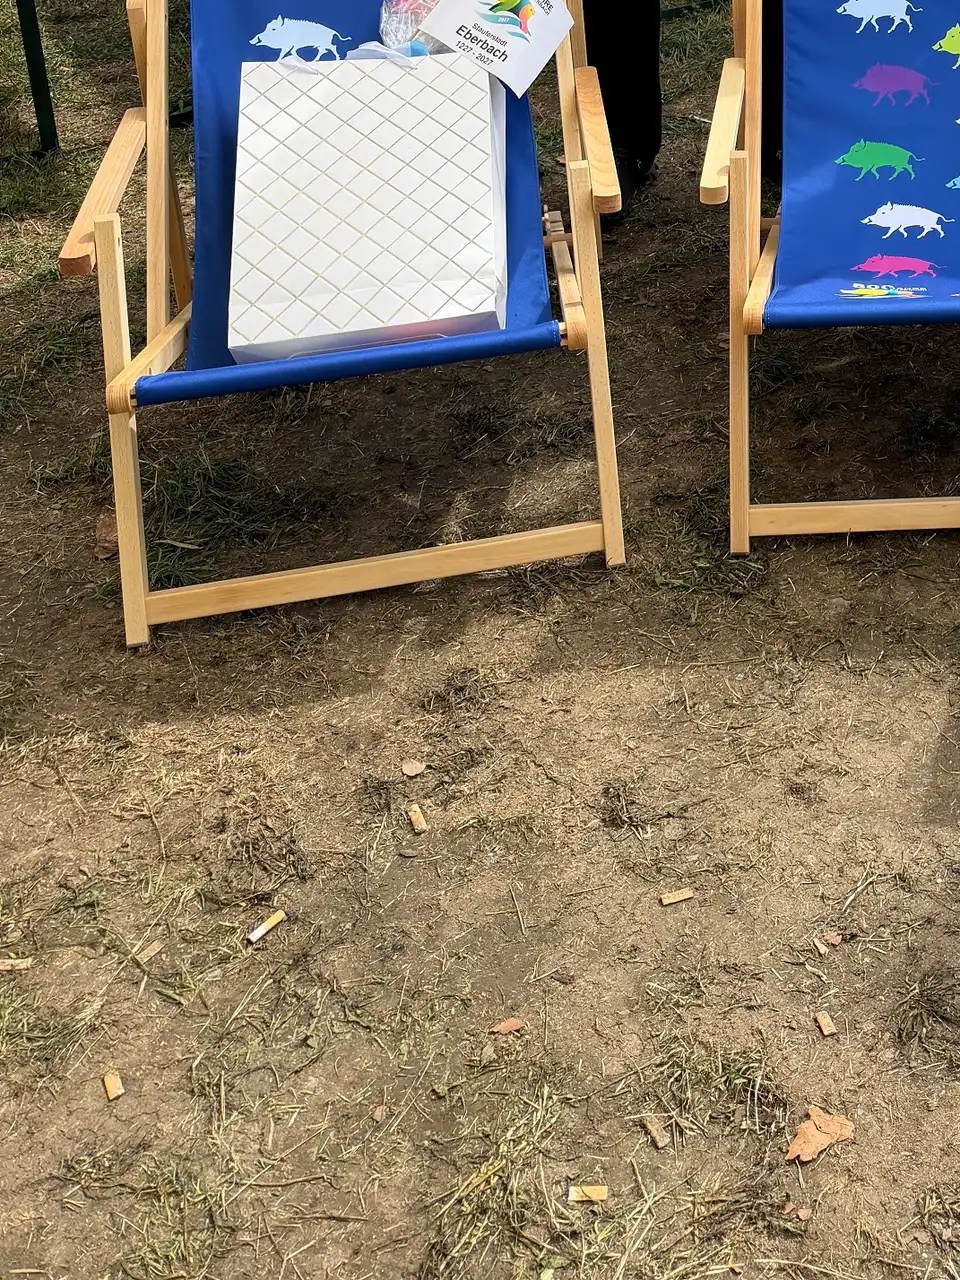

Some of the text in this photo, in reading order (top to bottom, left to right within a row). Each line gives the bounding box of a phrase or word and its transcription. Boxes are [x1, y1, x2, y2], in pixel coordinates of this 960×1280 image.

[455, 24, 509, 62] Eberbach
[472, 22, 508, 47] Stauferstadt
[455, 40, 473, 55] 1227
[475, 53, 494, 66] 2027
